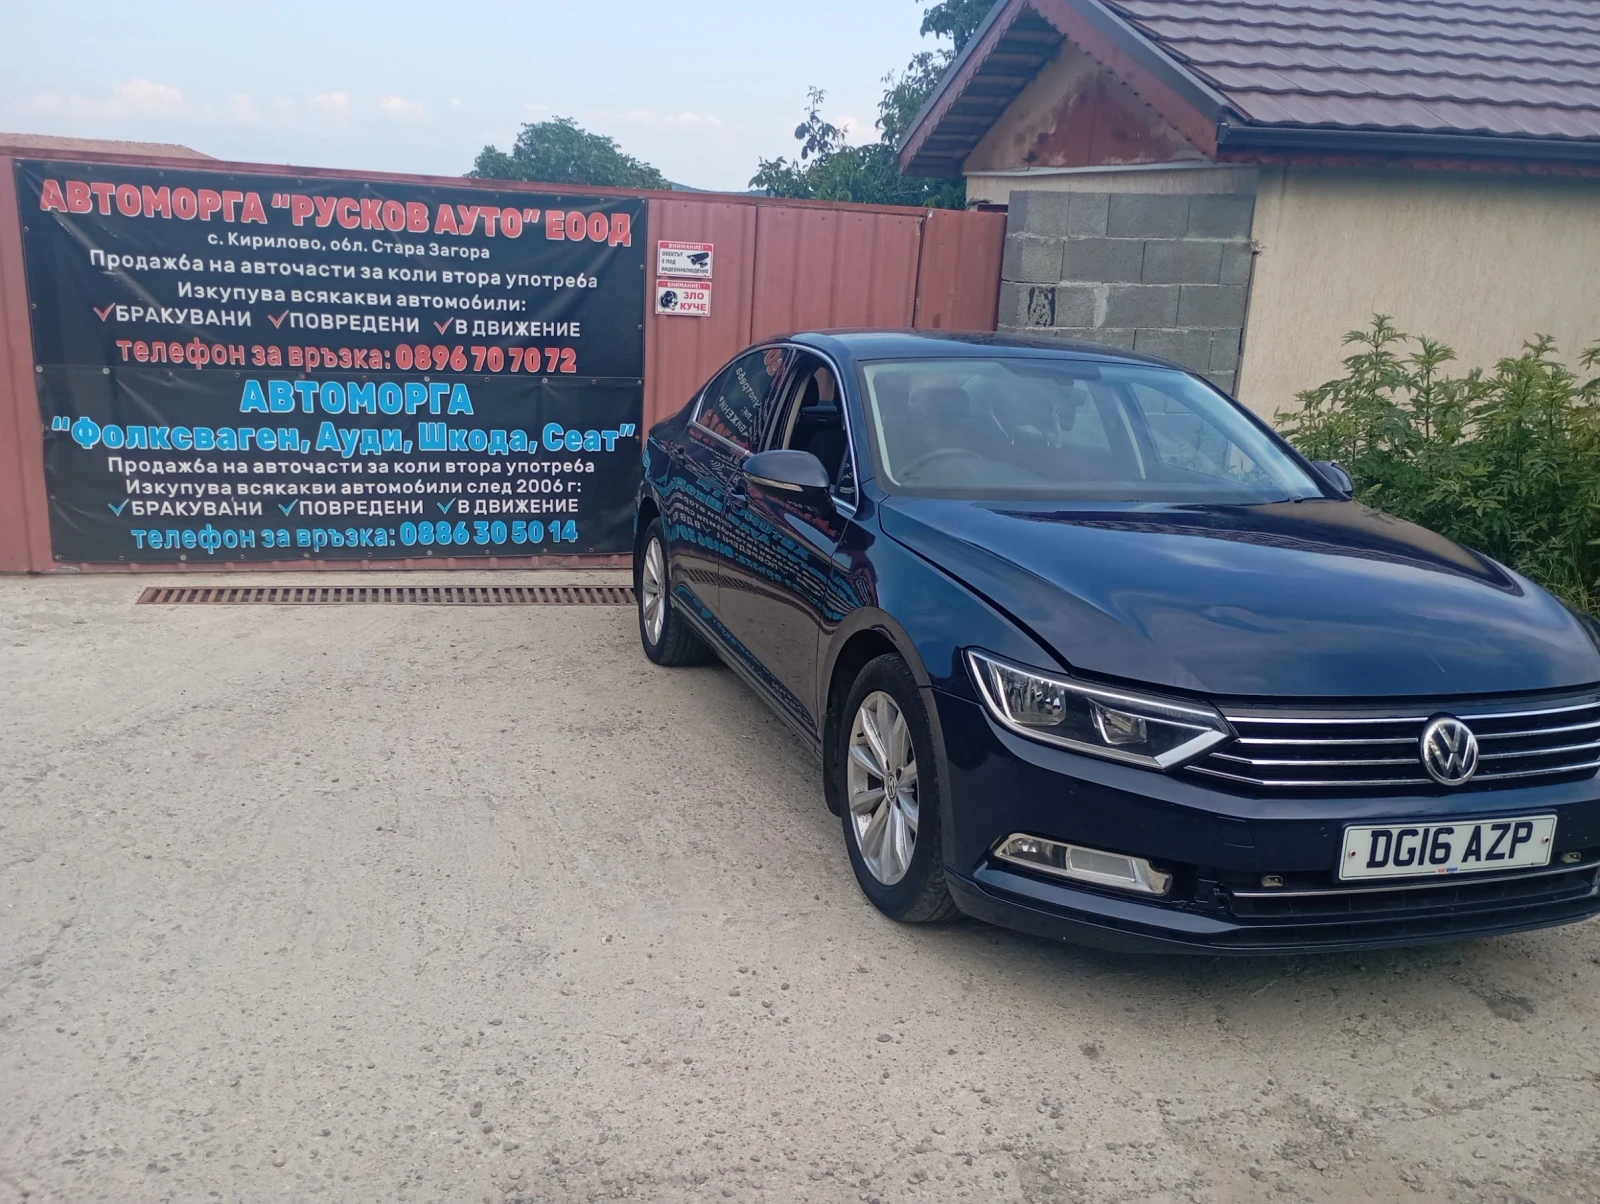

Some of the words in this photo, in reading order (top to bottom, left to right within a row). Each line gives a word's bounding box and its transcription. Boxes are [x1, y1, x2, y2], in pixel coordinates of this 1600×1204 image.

[40, 179, 267, 224] АВТОМОРГА
[545, 209, 632, 247] ЕООД
[207, 232, 224, 246] с.
[228, 231, 326, 251] Кирилово,
[330, 238, 368, 253] обл.
[372, 239, 425, 258] Стара
[429, 243, 490, 261] Загора
[90, 249, 204, 273] Продажба
[209, 259, 236, 273] на
[241, 260, 355, 278] авточасти
[360, 266, 383, 280] за
[388, 268, 437, 283] коли
[442, 270, 501, 287] втора
[506, 273, 598, 290] употреба
[177, 281, 285, 304] Изкупува
[291, 290, 392, 306] всякакви
[396, 294, 527, 312] автомобили:
[680, 302, 707, 311] КУЧЕ
[683, 291, 705, 300] ЗЛО
[116, 305, 252, 327] БРАКУВАНИ
[289, 312, 420, 334] ПОВРЕДЕНИ
[455, 319, 468, 335] В
[472, 320, 581, 338] ДВИЖЕНИЕ
[116, 337, 245, 370] телефон
[251, 345, 282, 366] за
[288, 346, 391, 372] връзка:
[395, 344, 467, 371] 0896
[471, 346, 504, 372] 70
[509, 347, 541, 373] 70
[544, 347, 577, 373] 72
[239, 379, 474, 416] АВТОМОРГА
[315, 421, 413, 459] Ауди,
[418, 422, 538, 455] Шкода,
[107, 456, 218, 476] Продажба
[223, 462, 248, 474] на
[252, 462, 363, 474] авточасти
[367, 462, 390, 474] за
[393, 461, 441, 474] коли
[445, 461, 502, 477] втора
[506, 459, 595, 477] употреба
[126, 479, 232, 498] Изкупува
[237, 482, 337, 495] всякакви
[340, 478, 463, 494] автомобили
[467, 480, 512, 495] след
[516, 479, 563, 493] 2006
[567, 480, 583, 493] г:
[131, 500, 264, 516] БРАКУВАНИ
[299, 500, 424, 517] ПОВРЕДЕНИ
[458, 499, 470, 514] В
[474, 498, 579, 515] ДВИЖЕНИЕ
[131, 523, 256, 554] телефон
[261, 528, 290, 548] за
[296, 527, 396, 552] връзка:
[399, 520, 470, 546] 0886
[473, 520, 508, 545] 30
[511, 520, 545, 545] 50
[548, 519, 579, 543] 14
[1423, 717, 1479, 786] VW
[1366, 827, 1455, 869] DG16
[1461, 821, 1534, 864] AZP
